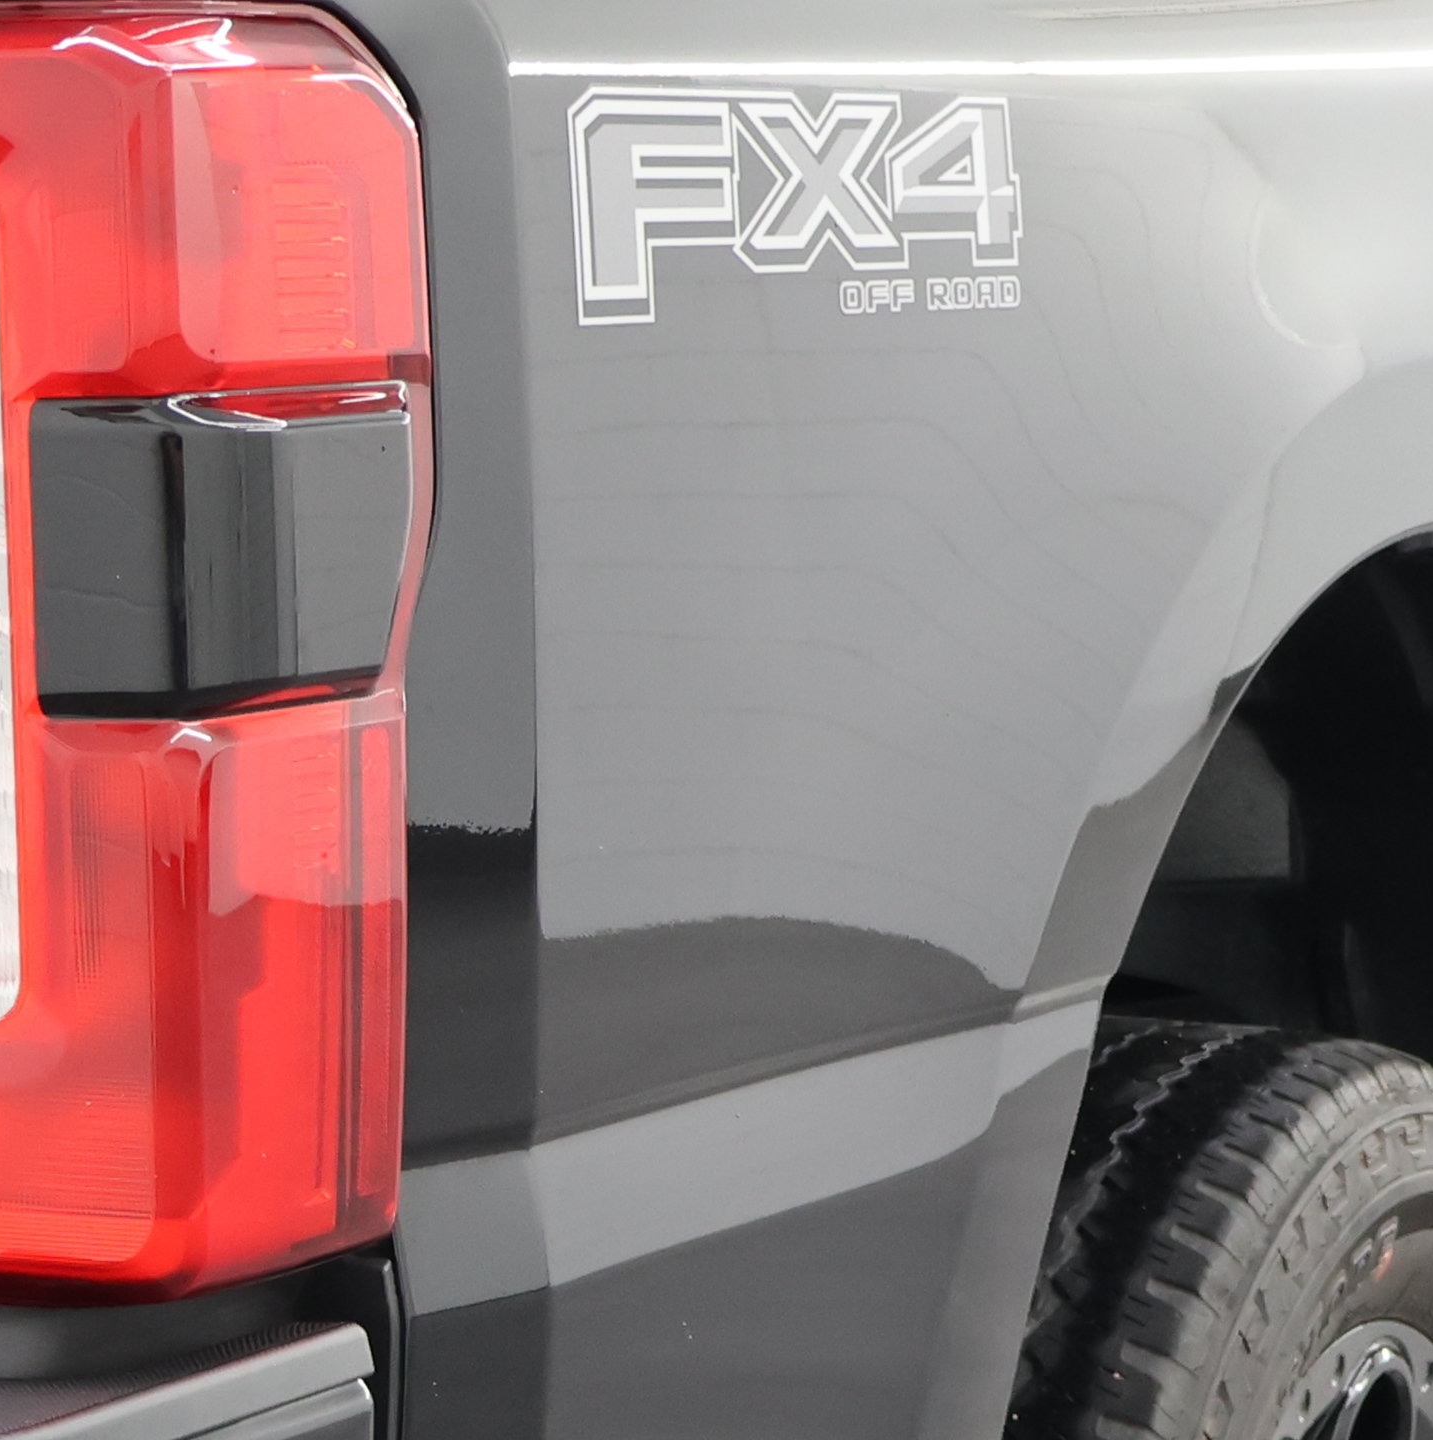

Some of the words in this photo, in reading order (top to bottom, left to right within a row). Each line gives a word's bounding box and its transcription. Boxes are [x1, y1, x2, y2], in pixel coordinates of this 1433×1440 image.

[567, 85, 1022, 326] FX4
[839, 279, 915, 315] OFF
[926, 275, 1022, 313] ROAD
